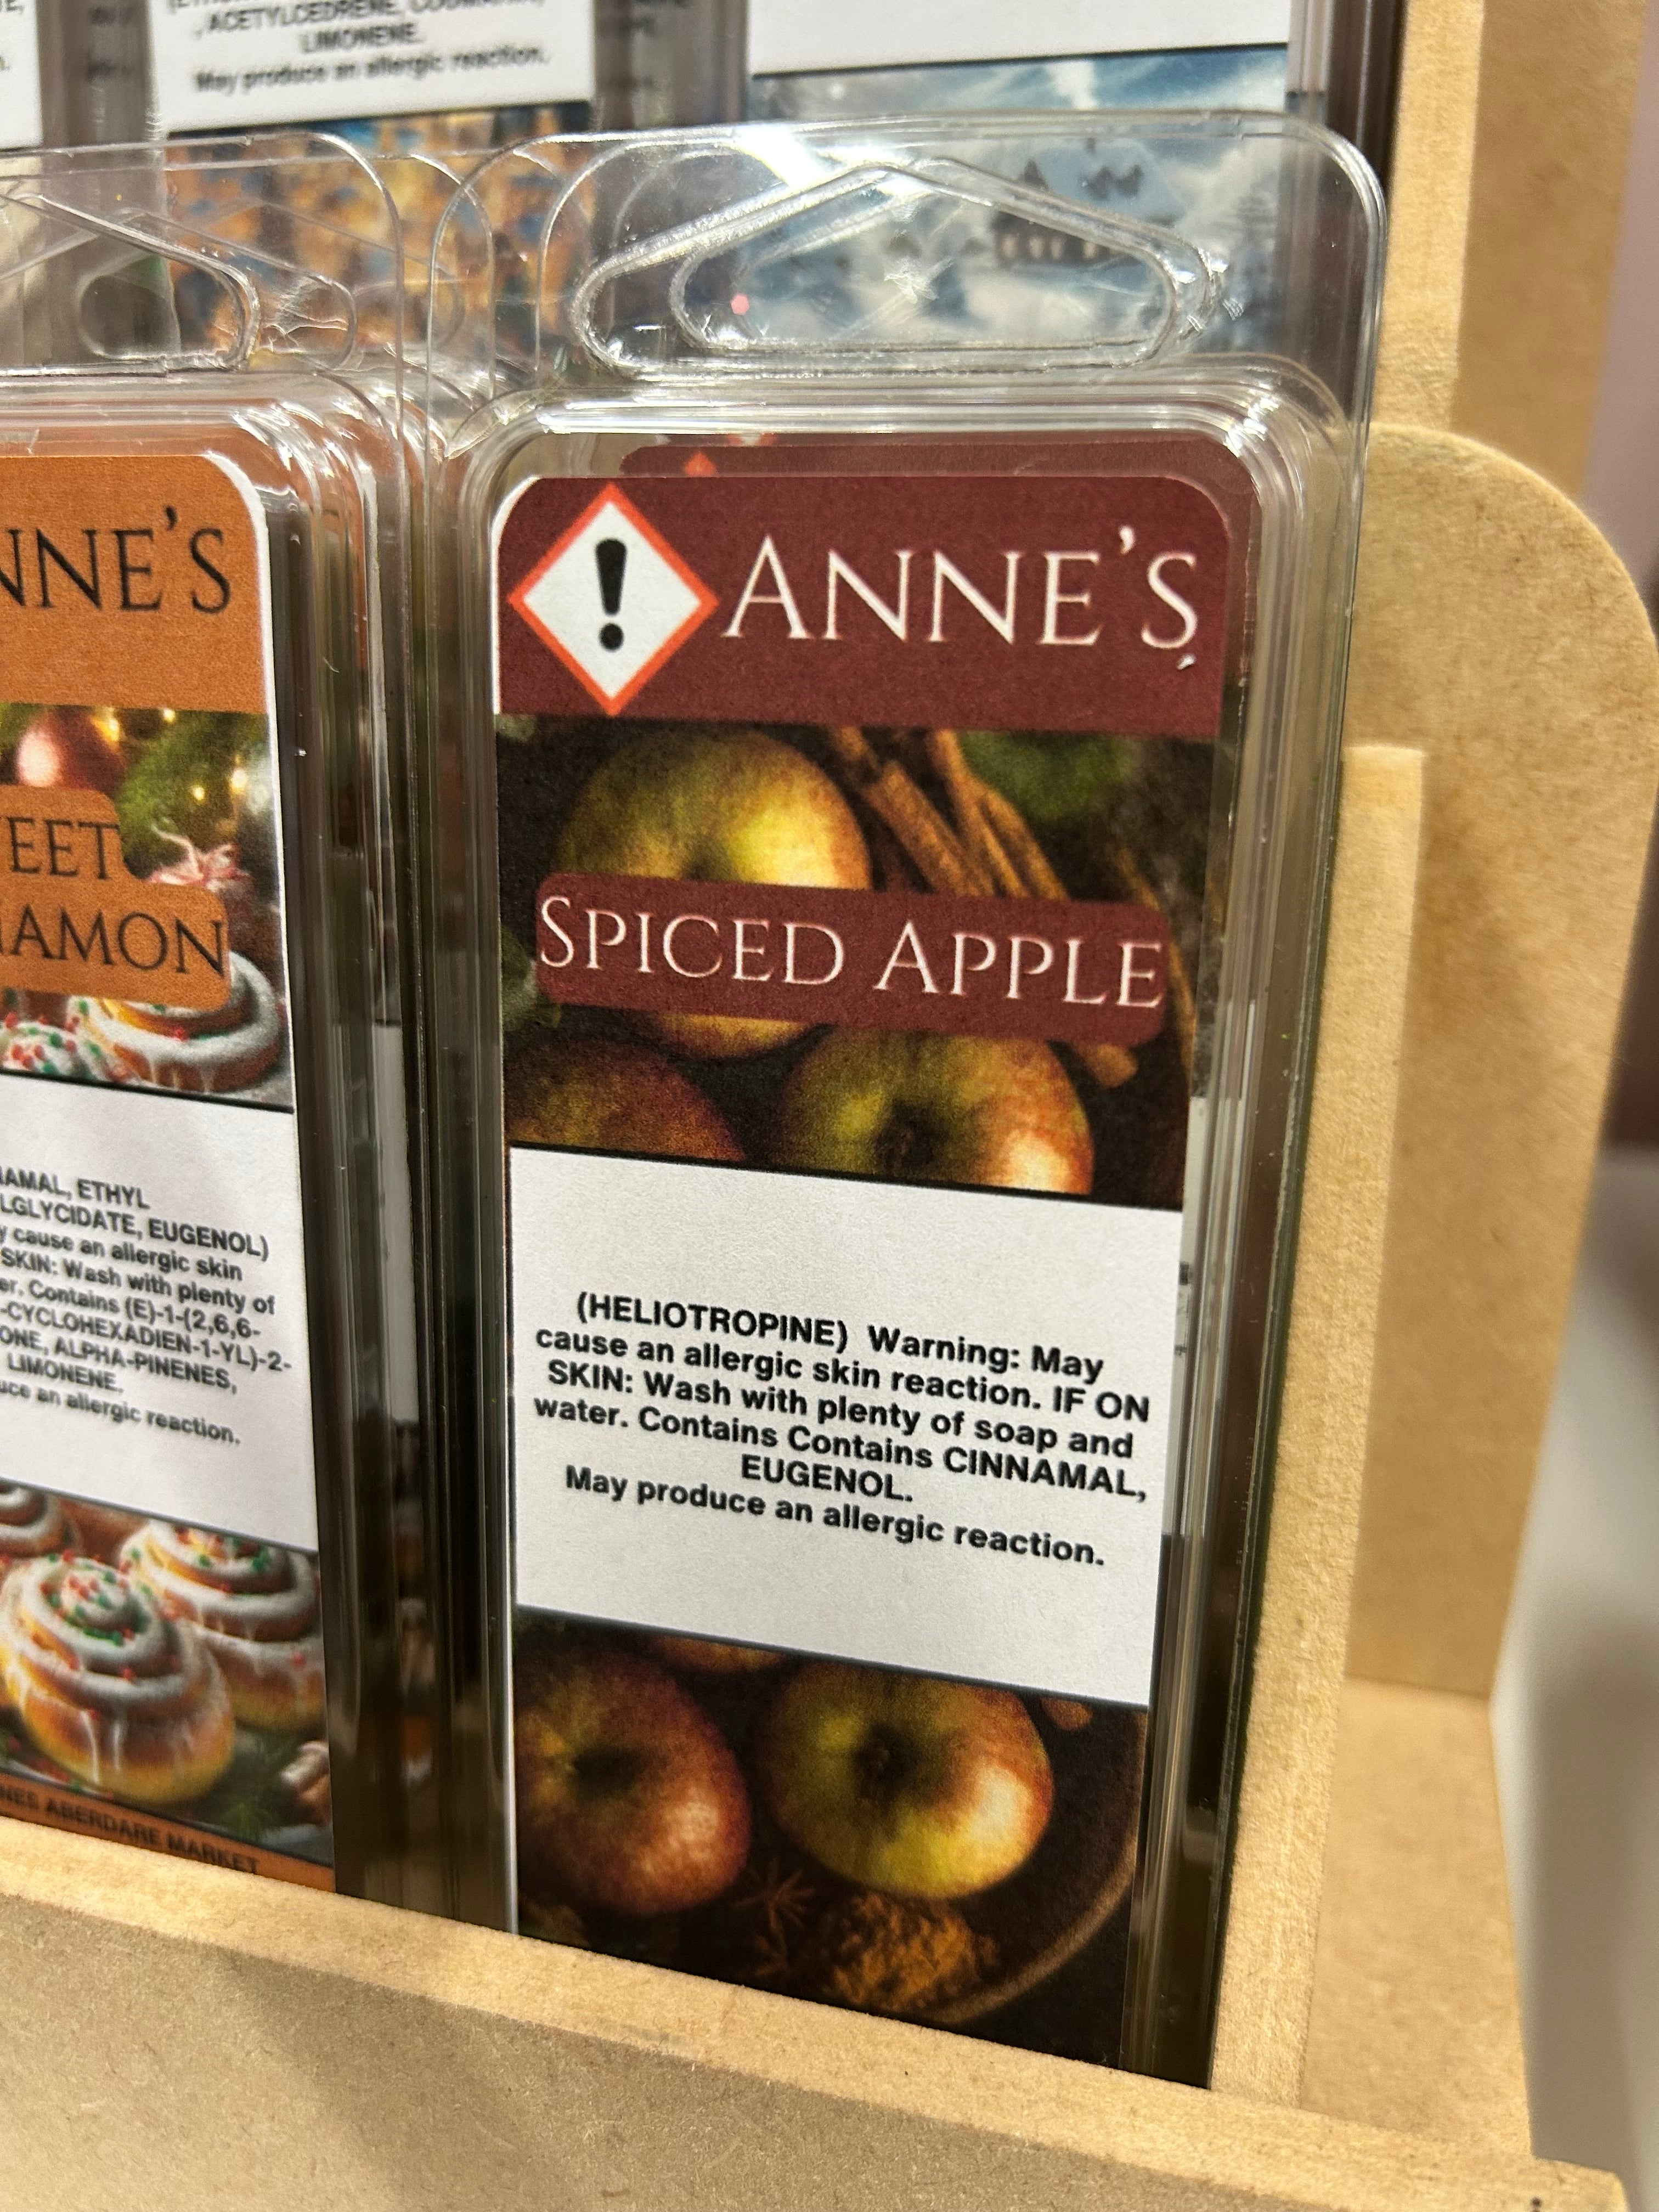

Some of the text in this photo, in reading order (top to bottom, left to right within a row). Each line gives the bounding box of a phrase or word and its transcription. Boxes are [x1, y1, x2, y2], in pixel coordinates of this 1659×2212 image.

[334, 61, 359, 78] an
[722, 526, 1198, 651] ANNE'S
[0, 904, 225, 978] AMON
[539, 897, 1164, 1009] SPICED APPLE
[0, 1166, 150, 1209] AMAL, ETHYL
[14, 1227, 74, 1251] cause
[80, 1239, 105, 1257] an
[112, 1243, 190, 1273] allergic
[198, 1256, 242, 1281] skin
[149, 1218, 269, 1261] EUGENOL)
[1, 1248, 275, 1314] SKIN: Wash with plenty of
[29, 1279, 120, 1313] Contains
[126, 1296, 261, 1339] (E)-1-(2,6,6-
[55, 1336, 236, 1394] ALPHA-PINENES,
[577, 1291, 1103, 1384] (HELIOTROPINE) Warning: May
[8, 1353, 123, 1392] LIMONENE.
[537, 1329, 1149, 1422] cause an allergic skin reaction. IF ON
[37, 1386, 61, 1405] an
[67, 1390, 142, 1423] allergic
[146, 1410, 240, 1445] reaction.
[549, 1359, 1132, 1458] SKIN: Wash with plenty of soap and
[535, 1397, 1146, 1502] water. Contains Contains CINNAMAL,
[742, 1454, 913, 1501] EUGENOL.
[566, 1465, 1104, 1565] May produce an allergic reaction.
